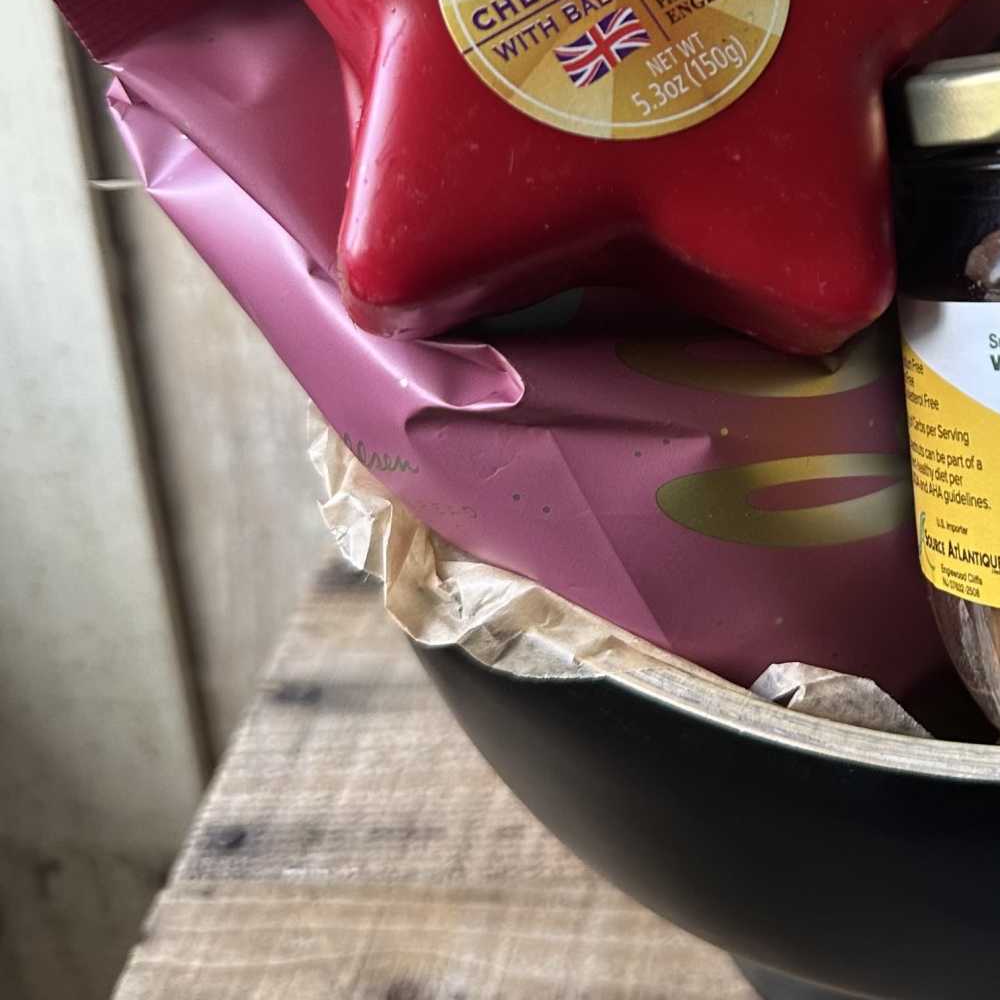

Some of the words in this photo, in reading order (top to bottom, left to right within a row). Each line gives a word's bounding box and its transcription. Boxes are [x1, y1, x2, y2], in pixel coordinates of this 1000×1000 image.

[493, 16, 562, 63] WITH
[646, 46, 682, 78] NET
[680, 31, 706, 60] WT
[631, 76, 689, 118] 5.3oz
[684, 35, 748, 90] (150g)
[936, 424, 970, 447] Serving
[946, 453, 965, 469] part
[965, 454, 975, 470] of
[976, 458, 984, 471] a
[949, 472, 964, 488] per
[943, 488, 992, 510] guidelines.
